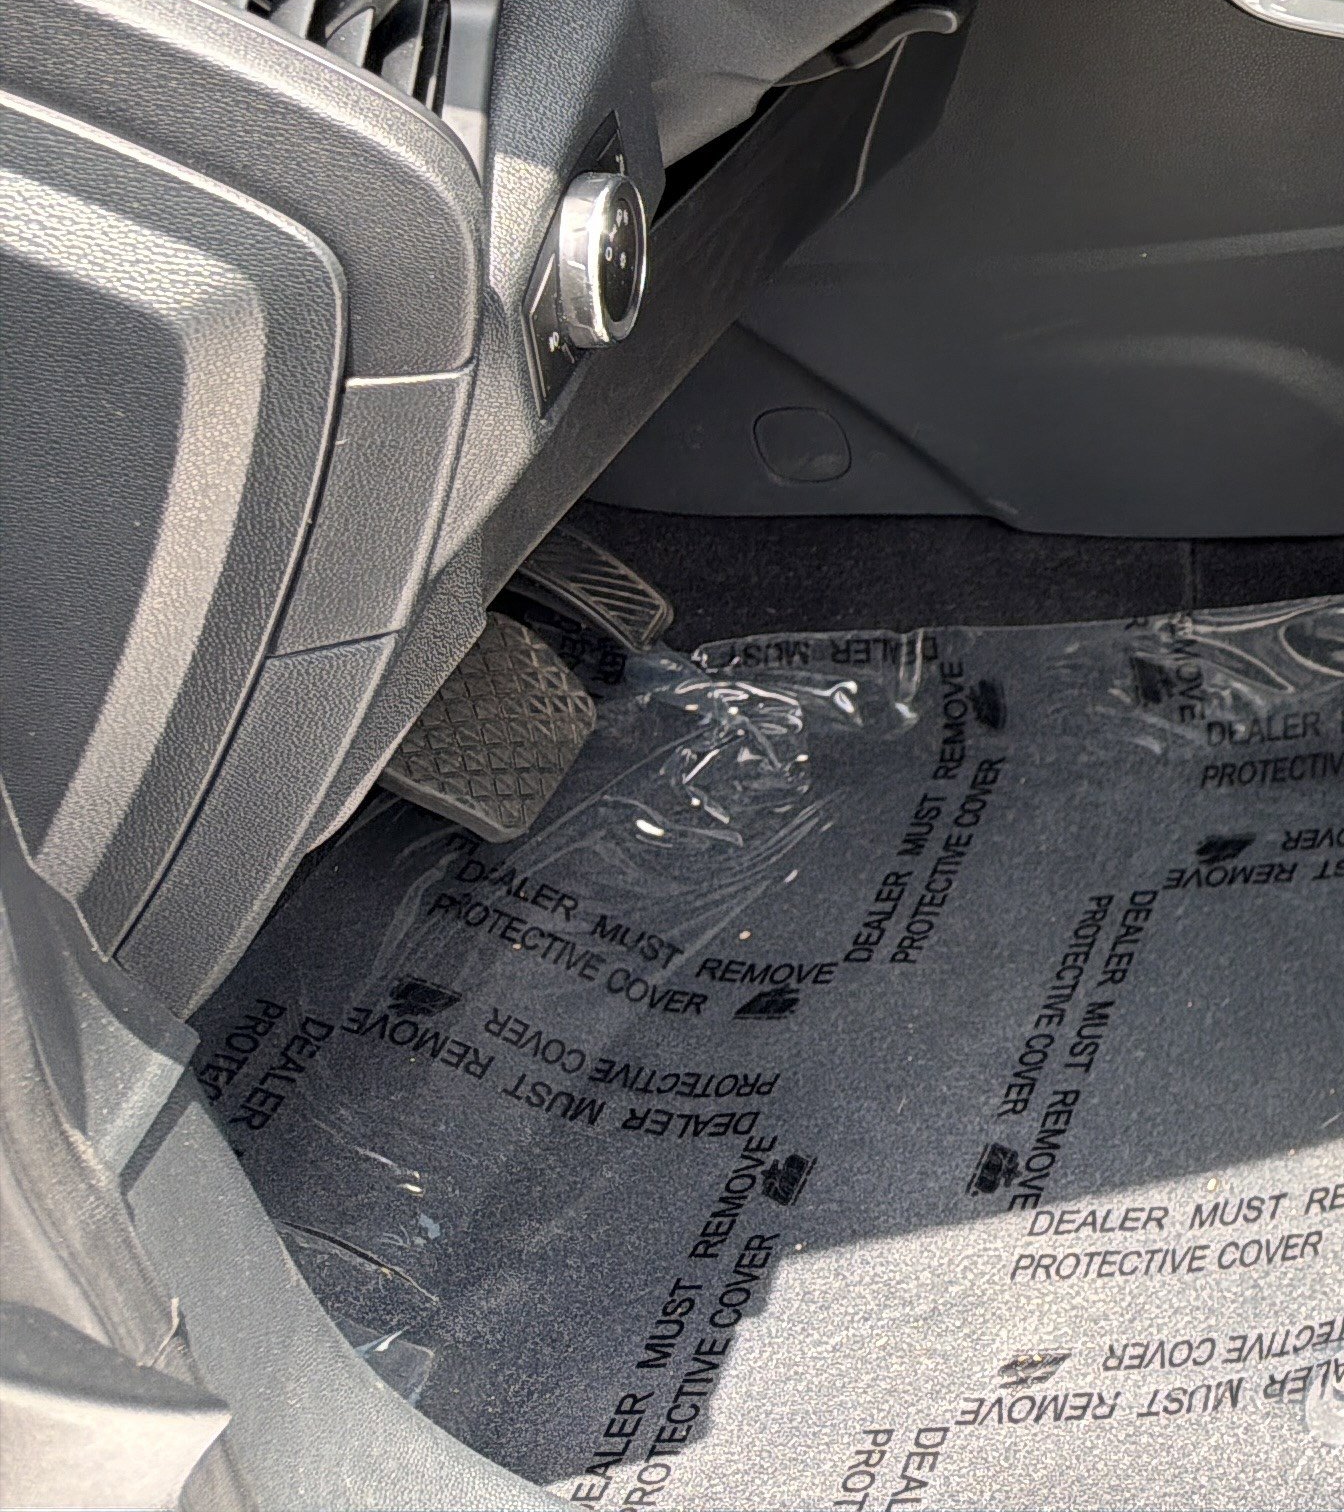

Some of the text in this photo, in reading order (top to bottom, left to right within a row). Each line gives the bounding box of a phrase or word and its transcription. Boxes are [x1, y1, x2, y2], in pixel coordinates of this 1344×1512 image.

[1205, 712, 1322, 749] DEALER
[843, 660, 968, 964] DEALER MUST REMOVE
[889, 756, 1007, 965] PROTECTIVE COVER
[455, 859, 839, 986] DEALER MUST REMOVE
[1164, 859, 1297, 889] REMOVE
[427, 893, 710, 1015] PROTECTIVE COVER
[998, 894, 1116, 1117] PROTECTIVE COVER
[228, 1016, 335, 1130] DEALER
[341, 1004, 762, 1139] DEALER MUST REMOVE
[483, 1006, 782, 1098] PROTECTIVE COVER
[1008, 889, 1159, 1211] DEALER MUST REMOVE
[1010, 1230, 1324, 1282] PROTECTIVE COVER
[1026, 1205, 1168, 1238] DEALER
[1188, 1192, 1290, 1231] MUST
[570, 1134, 779, 1511] EALER MUST REMOVE
[708, 1232, 781, 1330] COVER
[1101, 1337, 1218, 1372] COVER
[1137, 1374, 1248, 1419] MUST
[954, 1389, 1123, 1428] REMOVE
